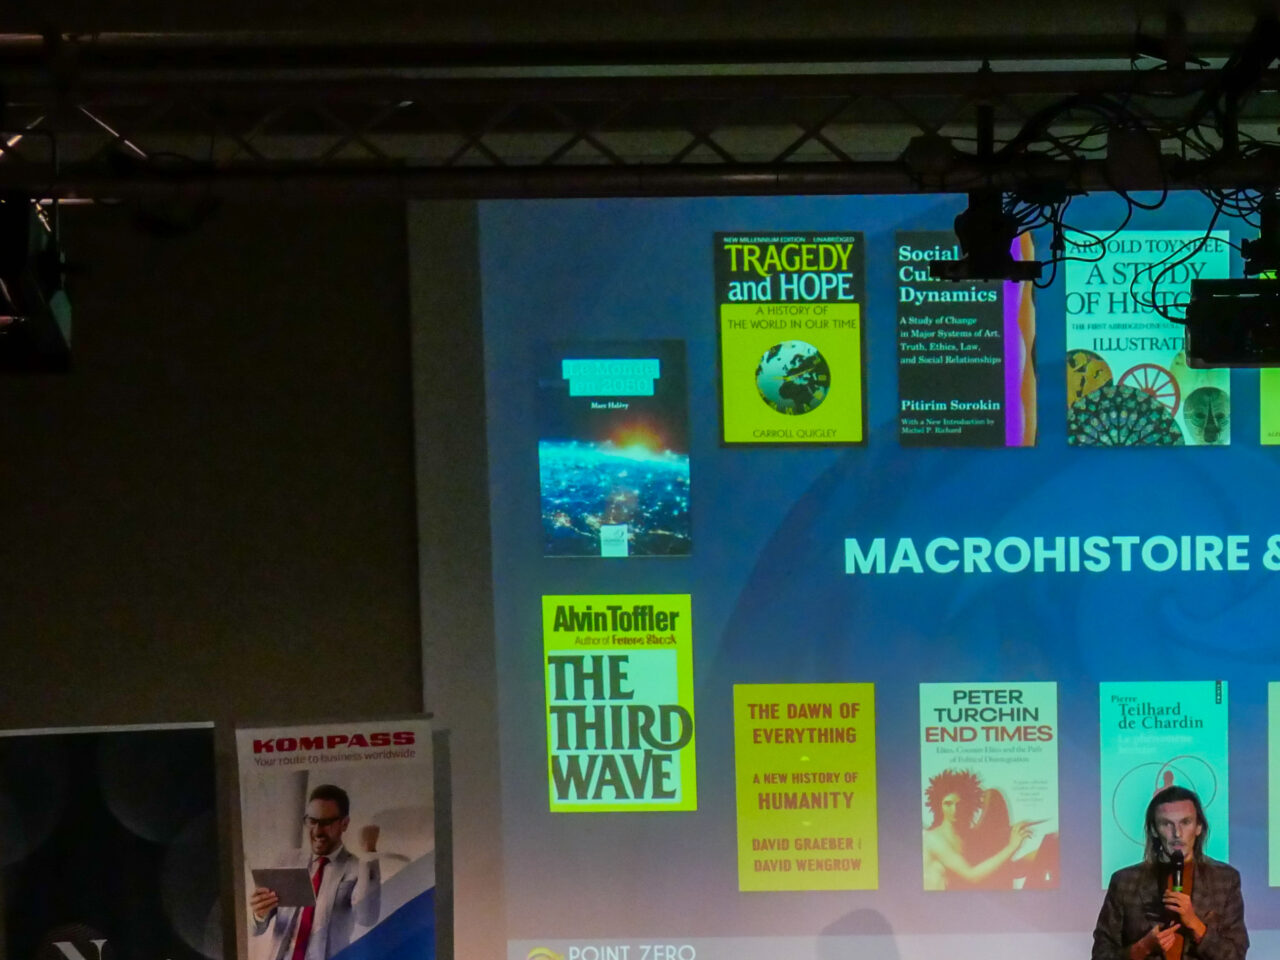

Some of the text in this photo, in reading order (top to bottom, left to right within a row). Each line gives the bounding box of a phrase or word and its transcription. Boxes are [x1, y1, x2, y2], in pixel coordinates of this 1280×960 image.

[898, 246, 958, 260] Social
[724, 244, 854, 277] TRAGEDY
[1086, 262, 1208, 284] A STUDY
[728, 272, 854, 300] and HOPE
[899, 286, 997, 306] Dynamics
[1066, 290, 1191, 314] OF HISTO
[756, 306, 828, 315] A HISTORY OF
[728, 320, 856, 329] THE WORLD IN OUR TIME
[909, 316, 932, 326] Study
[935, 316, 944, 324] of
[945, 316, 976, 326] Change
[911, 330, 936, 339] Major
[938, 330, 972, 338] Systems
[900, 343, 927, 351] Truth,
[960, 343, 980, 351] Law,
[1093, 337, 1186, 351] ILLUSTRAT
[900, 356, 1001, 365] and Social Relationships
[901, 400, 1000, 410] Pitirim Sorokin
[753, 429, 837, 438] CARROLL QUIGLEY
[844, 535, 1250, 574] MACROHISTOIRE
[553, 605, 680, 632] Alvin Toffler
[575, 636, 610, 645] Author of
[548, 655, 634, 700] THE
[953, 690, 1023, 704] PETER
[1111, 695, 1138, 703] Pierre
[748, 702, 860, 719] THE DAWN OF
[934, 707, 1039, 722] TURCHIN
[1118, 702, 1181, 716] Teilhard
[550, 704, 694, 752] THIRD
[1118, 715, 1204, 729] de Chardin
[754, 728, 856, 744] EVERYTHING
[925, 725, 1054, 742] END TIMES
[253, 732, 416, 754] KOMPASS
[255, 749, 416, 767] Your route to business worldwide
[551, 750, 676, 800] WAVE
[753, 772, 858, 784] A NEW HISTORY OF
[758, 792, 854, 810] HUMANITY
[752, 838, 789, 852] DAVID
[795, 838, 854, 850] GRAEBER
[754, 858, 862, 872] DAVID WENGROW
